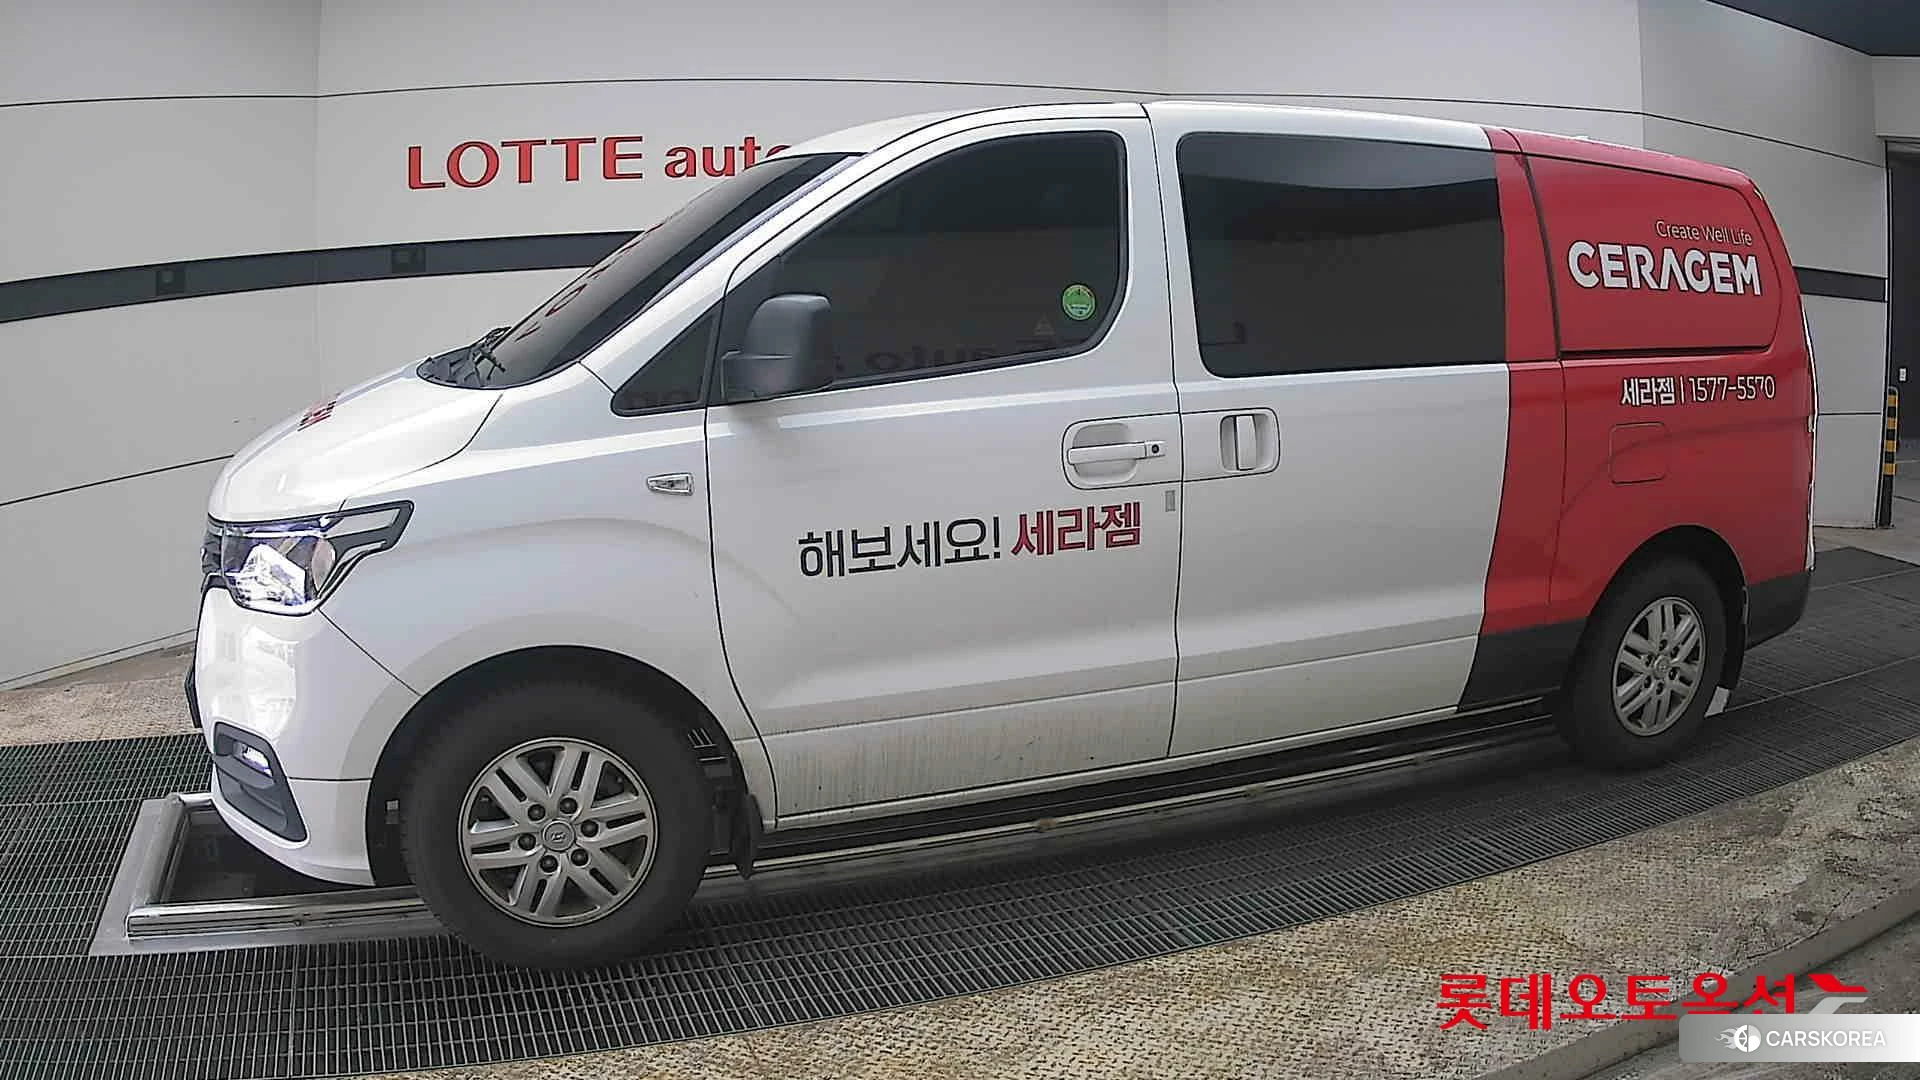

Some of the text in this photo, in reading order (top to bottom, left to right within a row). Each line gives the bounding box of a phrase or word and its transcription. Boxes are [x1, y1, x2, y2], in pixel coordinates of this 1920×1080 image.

[407, 136, 793, 190] LOTTE aut
[1655, 220, 1754, 247] Create Well Life
[1567, 240, 1762, 296] CERAGEM
[1621, 376, 1676, 406] 세라젬
[1688, 375, 1776, 402] 1577-5570
[797, 501, 1143, 578] 해보세요! 세라젬
